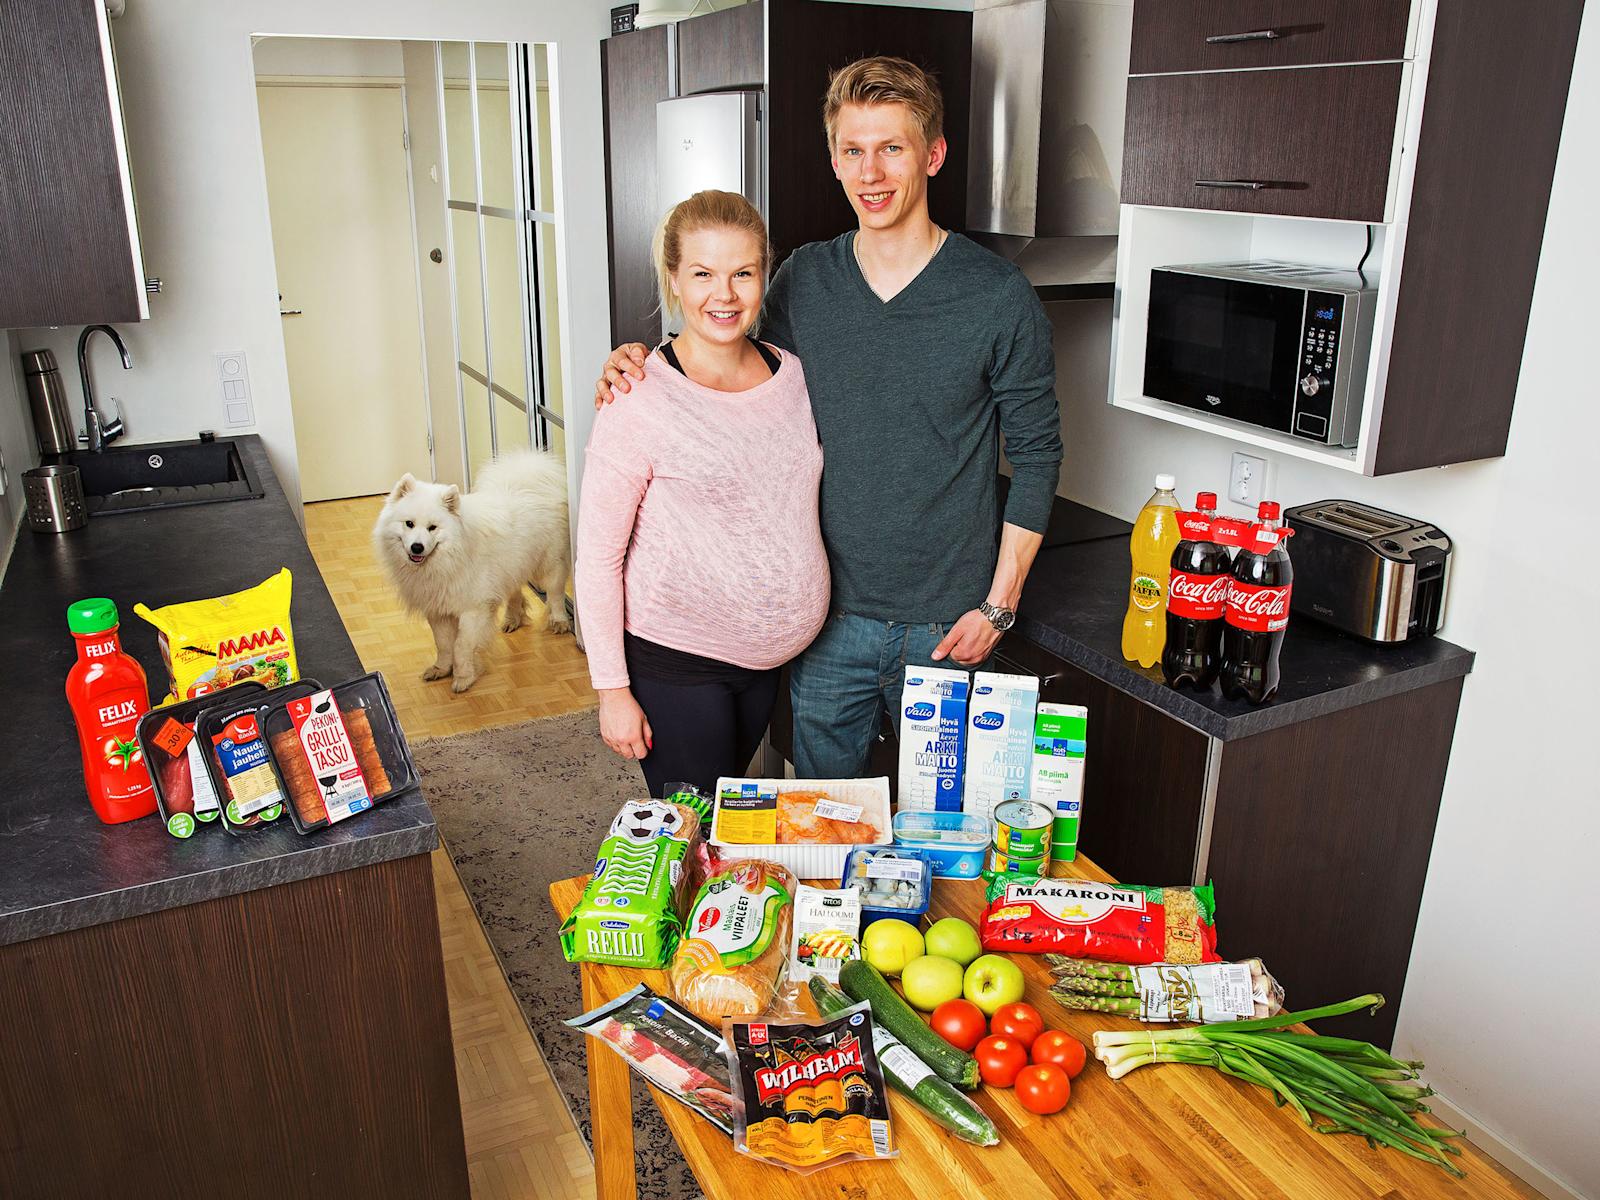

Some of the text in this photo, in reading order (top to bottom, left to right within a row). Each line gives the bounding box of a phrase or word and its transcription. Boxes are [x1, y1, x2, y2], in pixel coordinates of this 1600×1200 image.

[1133, 584, 1160, 597] JAFFA
[1171, 575, 1228, 603] Coca-Col
[86, 641, 116, 657] FELIX
[218, 627, 286, 660] MAMA
[99, 700, 137, 722] FELIX
[906, 708, 933, 718] Valio
[311, 712, 339, 730] PEKONI-
[941, 718, 958, 726] Hyvä
[974, 716, 1001, 727] Valio
[307, 726, 344, 751] GRILLI-
[313, 744, 349, 770] TASSU
[925, 741, 958, 755] ARKI
[915, 752, 958, 768] MAITO
[993, 751, 1026, 766] ARKI
[982, 761, 1025, 780] MAITO
[1049, 771, 1069, 779] piimä
[1016, 887, 1135, 903] MAKARONI
[723, 904, 737, 932] Maalais
[732, 896, 749, 941] VIIPALEET
[587, 929, 645, 957] REILU
[665, 1028, 690, 1047] Bacon
[761, 1050, 858, 1090] WILHELM
